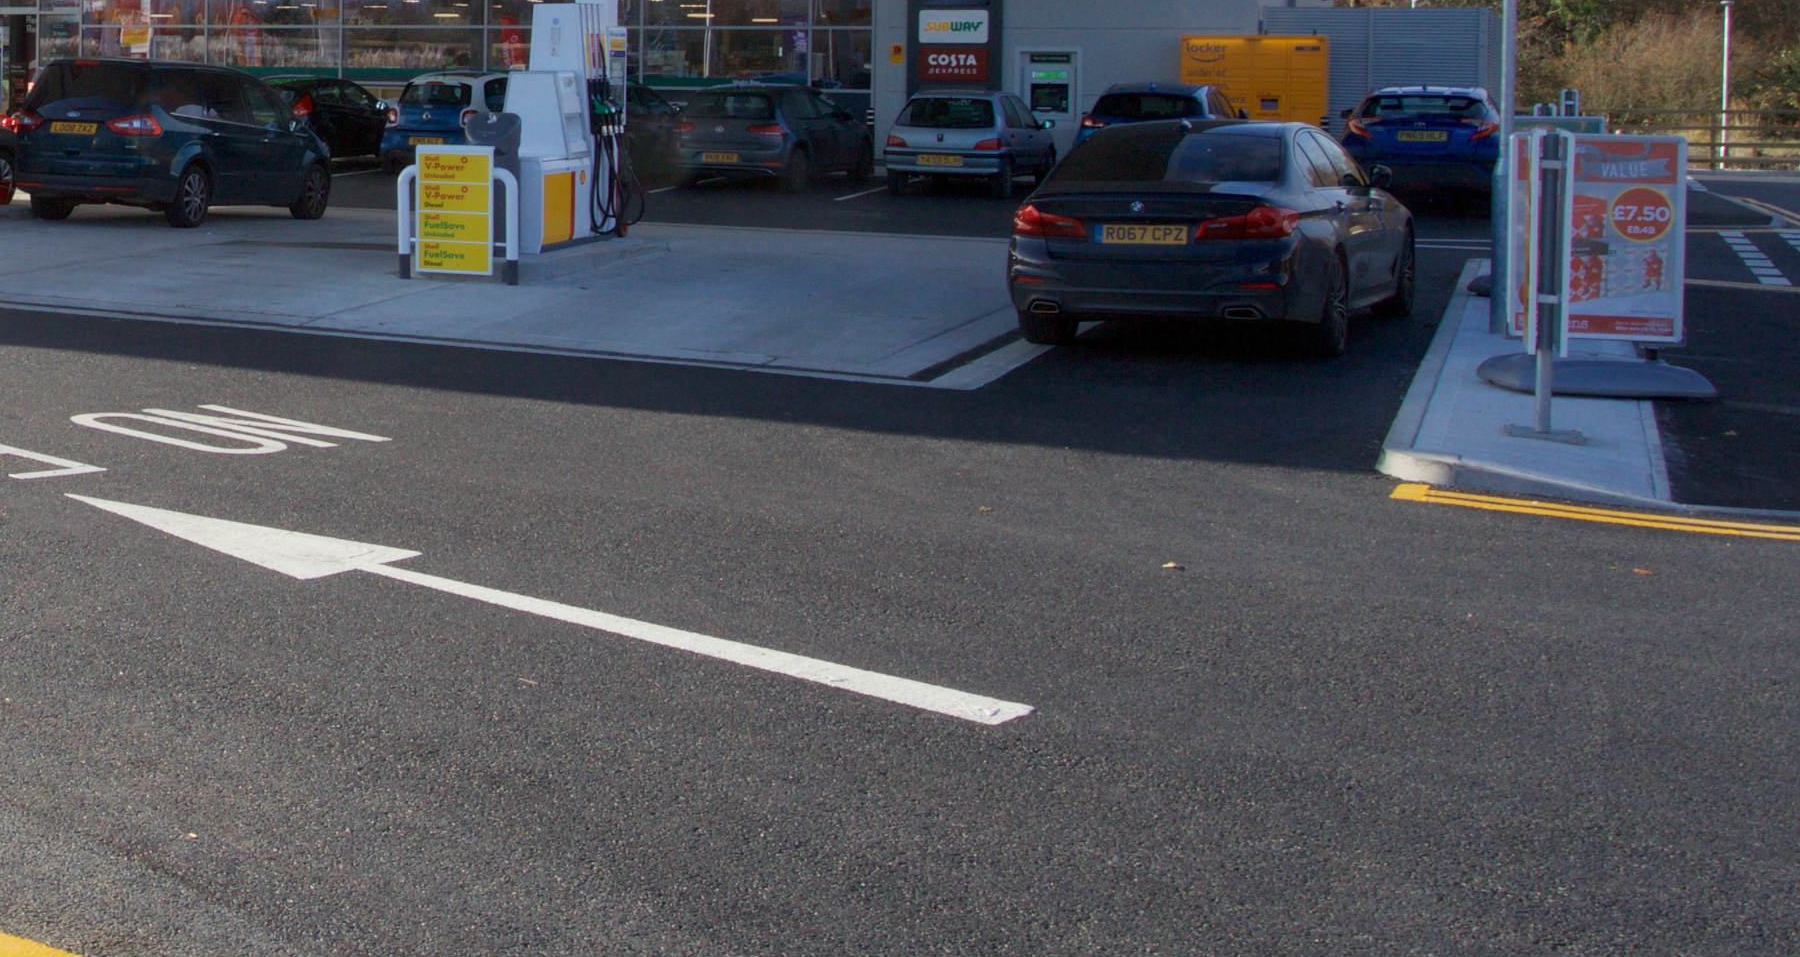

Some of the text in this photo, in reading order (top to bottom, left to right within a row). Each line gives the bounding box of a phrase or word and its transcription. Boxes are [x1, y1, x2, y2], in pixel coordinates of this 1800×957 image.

[924, 21, 984, 32] SUBWAY
[1186, 42, 1227, 53] locker
[927, 54, 977, 66] COSTA
[425, 162, 465, 171] V-Power
[1600, 161, 1649, 179] VALUE
[425, 192, 465, 200] V-Power
[1613, 205, 1671, 222] £7.50
[1106, 226, 1185, 241] RO67 CPZ
[70, 404, 393, 455] NO
